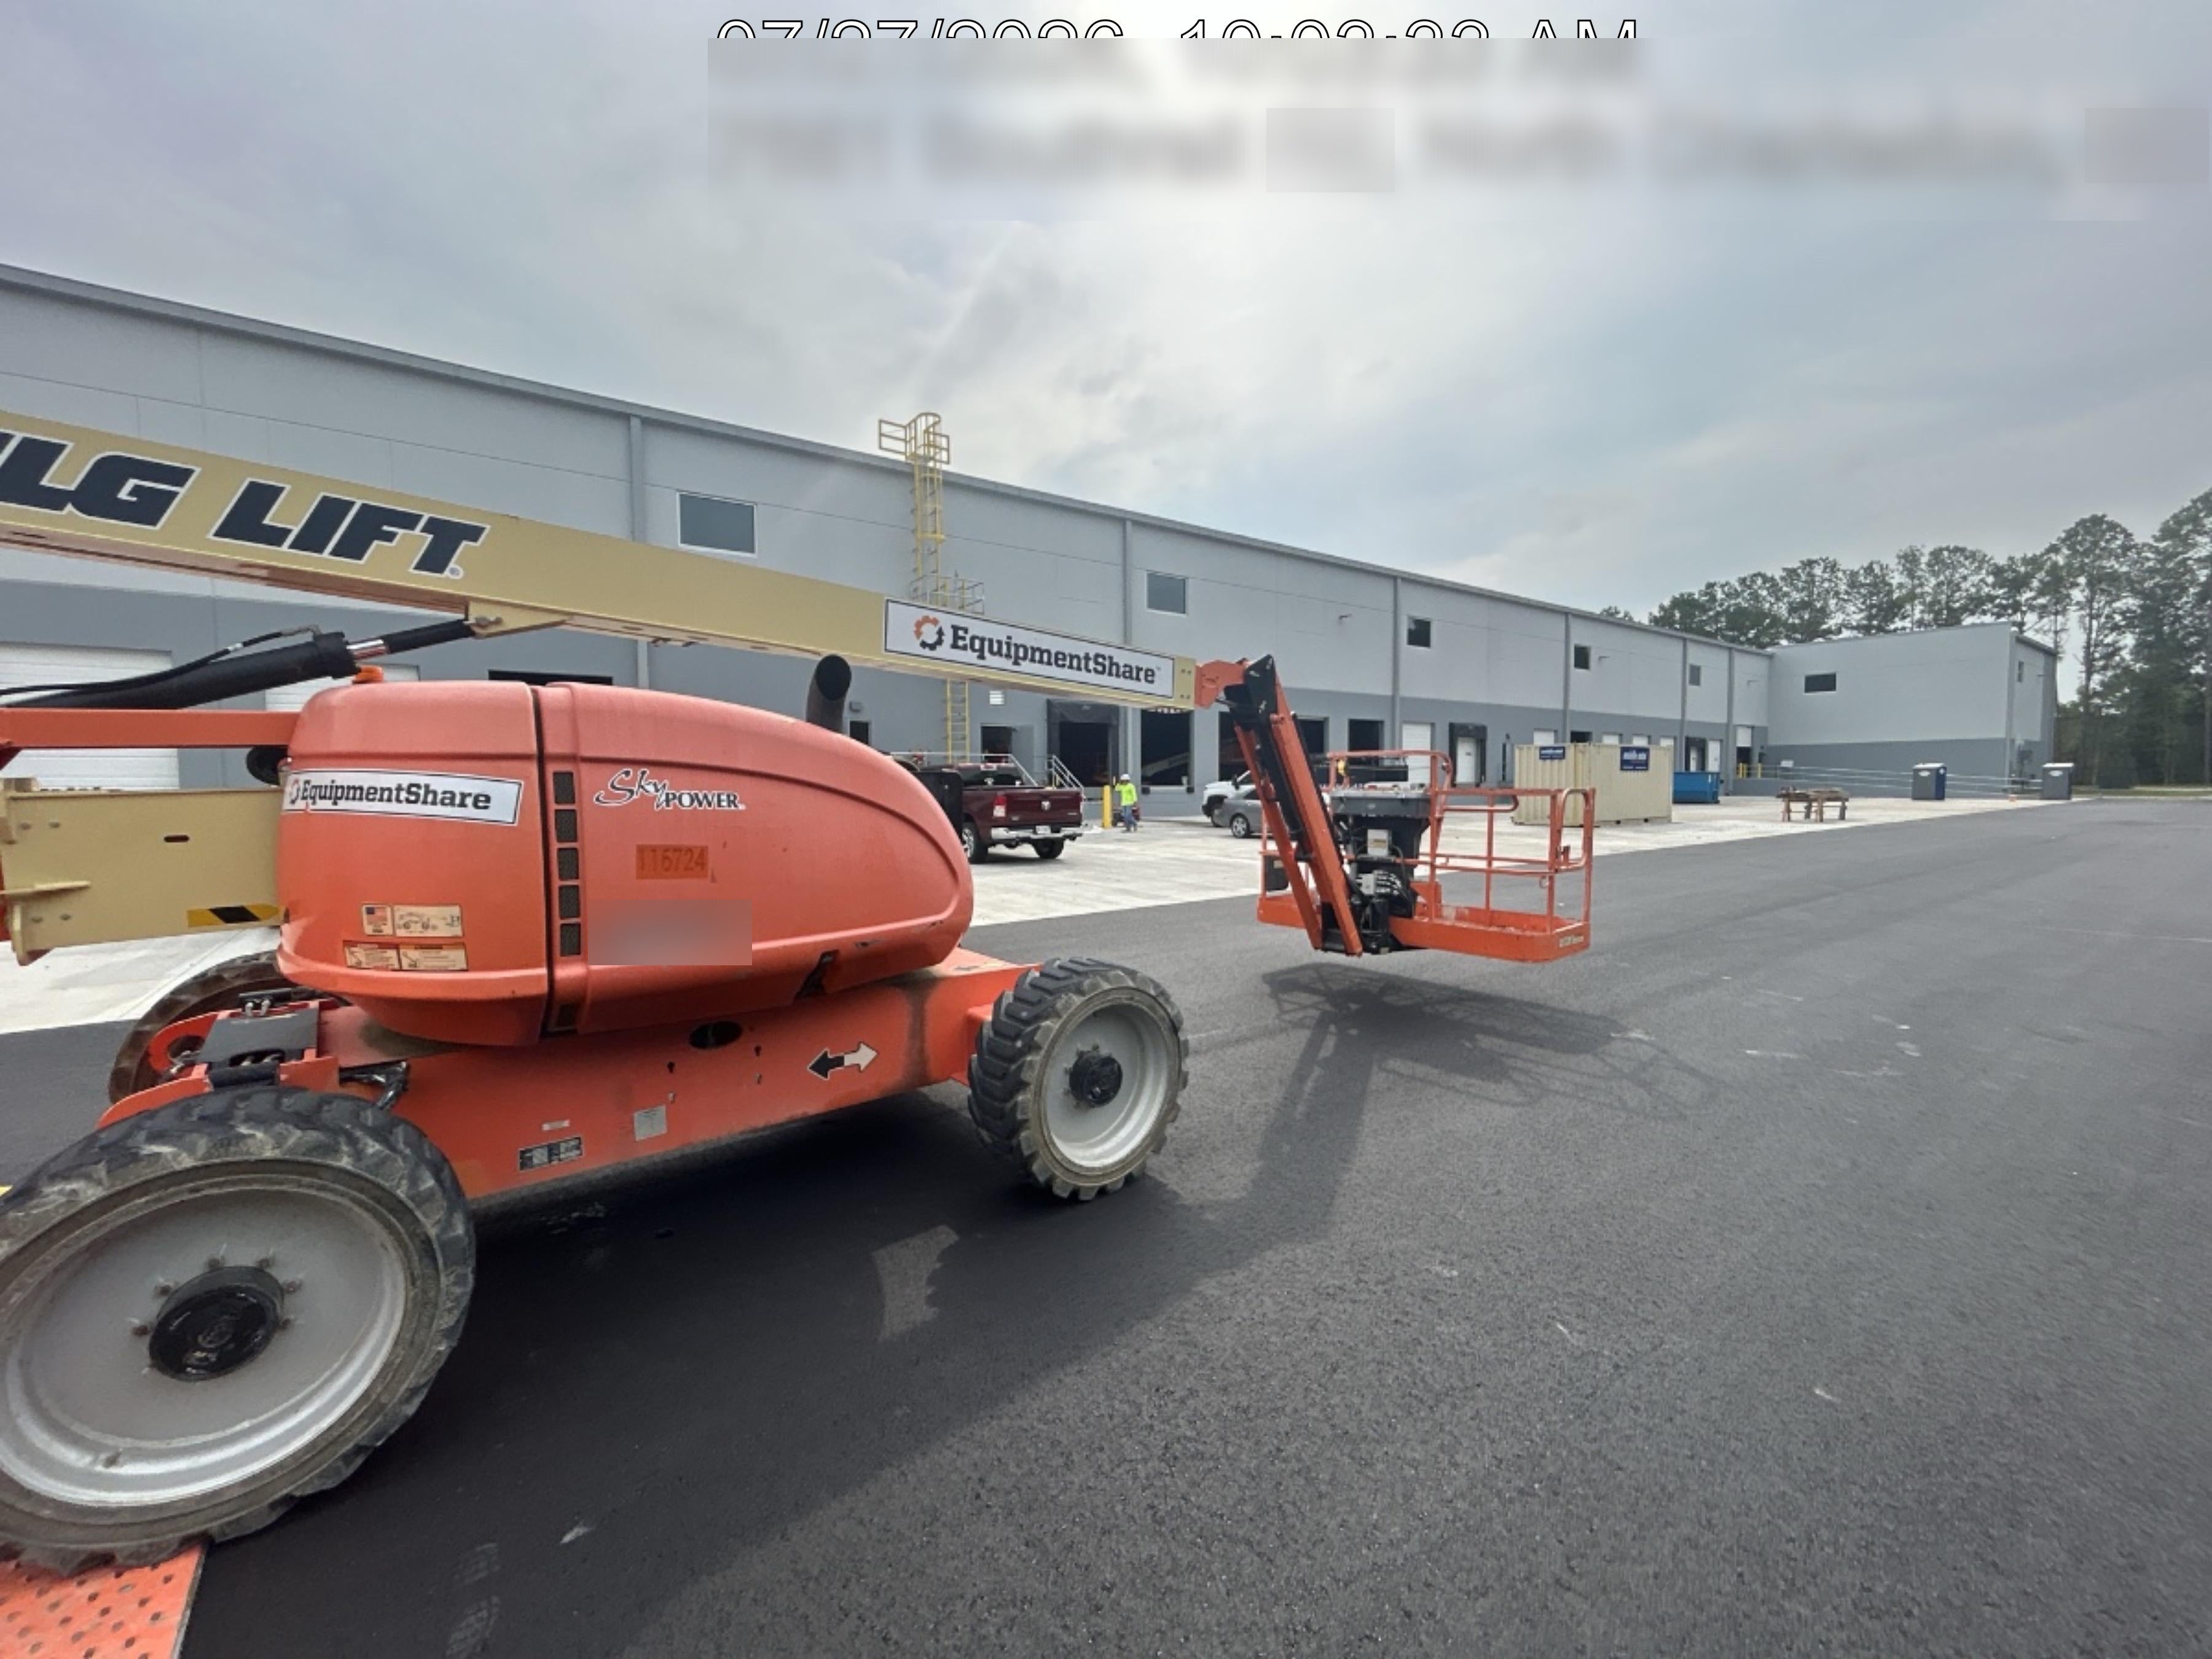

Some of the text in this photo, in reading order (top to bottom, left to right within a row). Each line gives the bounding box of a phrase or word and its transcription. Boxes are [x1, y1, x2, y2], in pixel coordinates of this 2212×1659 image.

[0, 429, 490, 577] LG LIFT
[950, 624, 1156, 684] EquipmentShare
[300, 779, 491, 810] EquipmentShare
[638, 848, 706, 873] 116724
